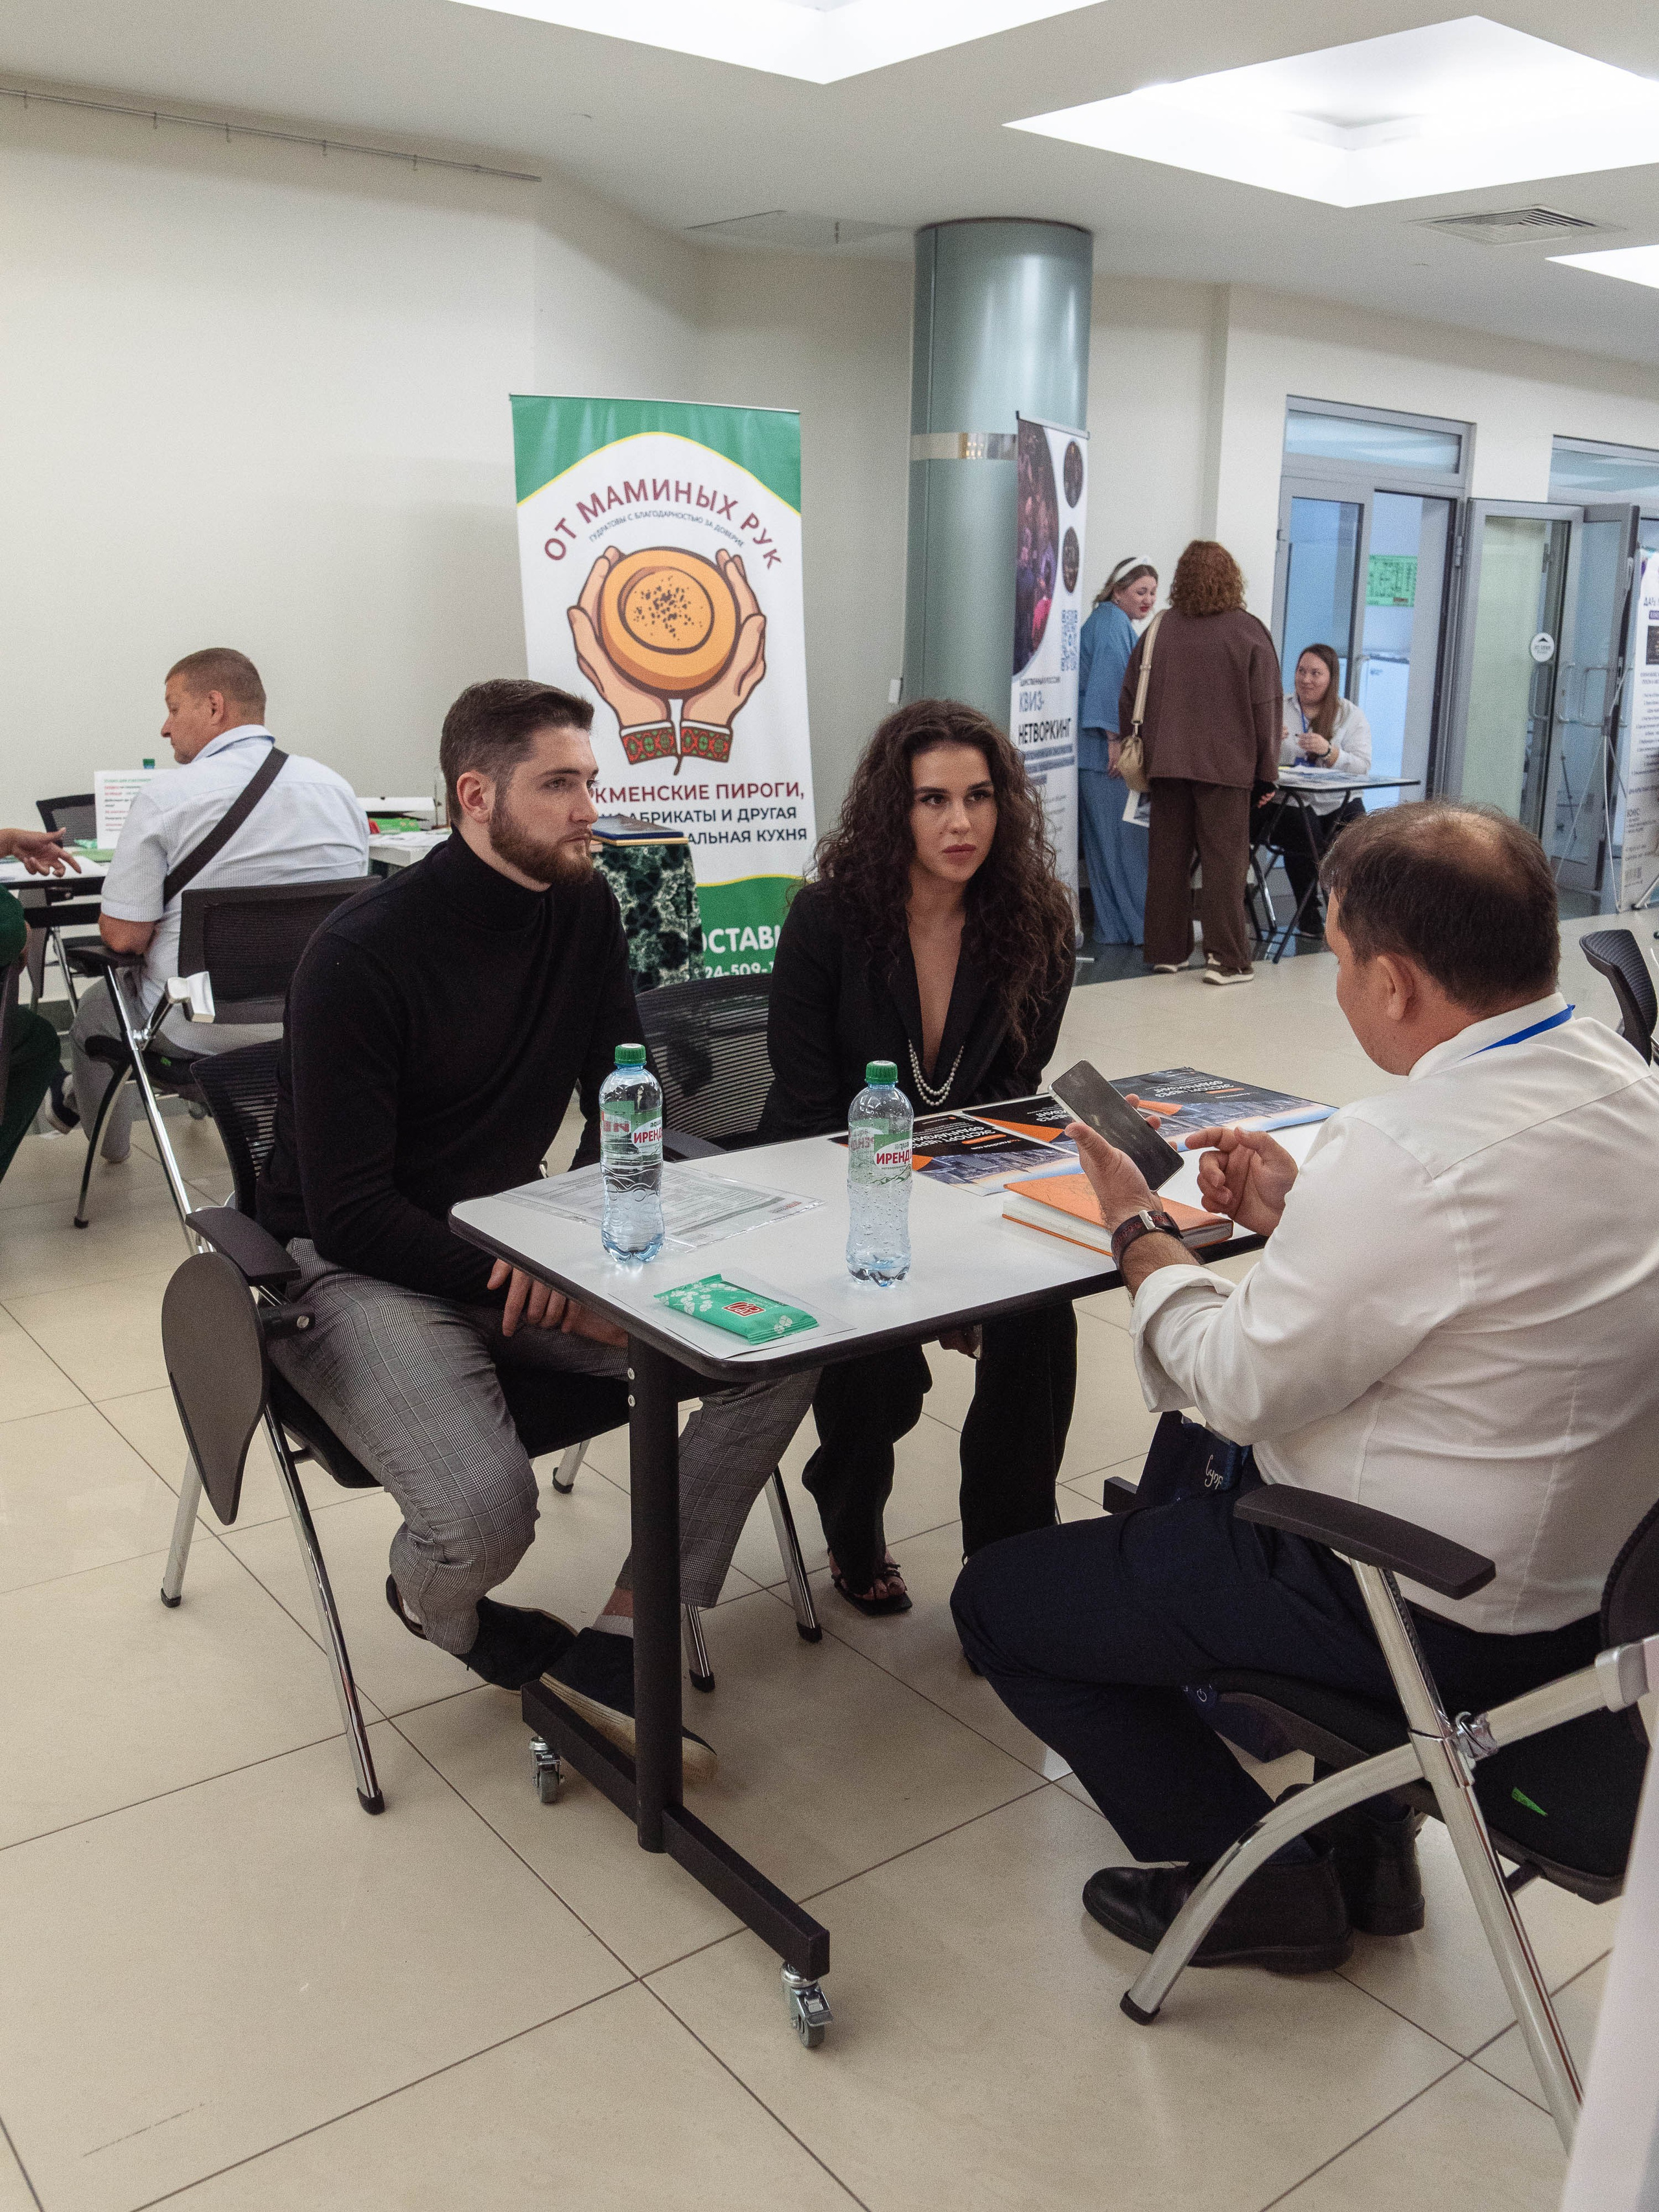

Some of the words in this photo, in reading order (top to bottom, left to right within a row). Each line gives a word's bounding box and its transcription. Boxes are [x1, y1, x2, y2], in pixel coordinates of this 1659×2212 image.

[544, 517, 577, 561] ОТ
[575, 478, 739, 524] МАМИНЫХ
[739, 513, 782, 570] РУК
[634, 510, 704, 524] БЛАГОДАРНОСТЬЮ
[1017, 717, 1071, 745] НЕТВОРКИНГ
[590, 784, 709, 804] КМЕНСКИЕ
[715, 782, 805, 800] ПИРОГИ,
[721, 809, 732, 822] И
[737, 807, 797, 823] ДРУГАЯ
[688, 829, 751, 844] АЛЬНАЯ
[757, 828, 807, 842] КУХНЯ
[634, 1126, 662, 1144] ИРЕНД
[912, 1126, 984, 1143] ФРАНЧАЙЗИН
[943, 1129, 996, 1144] ЭКСПОРТ
